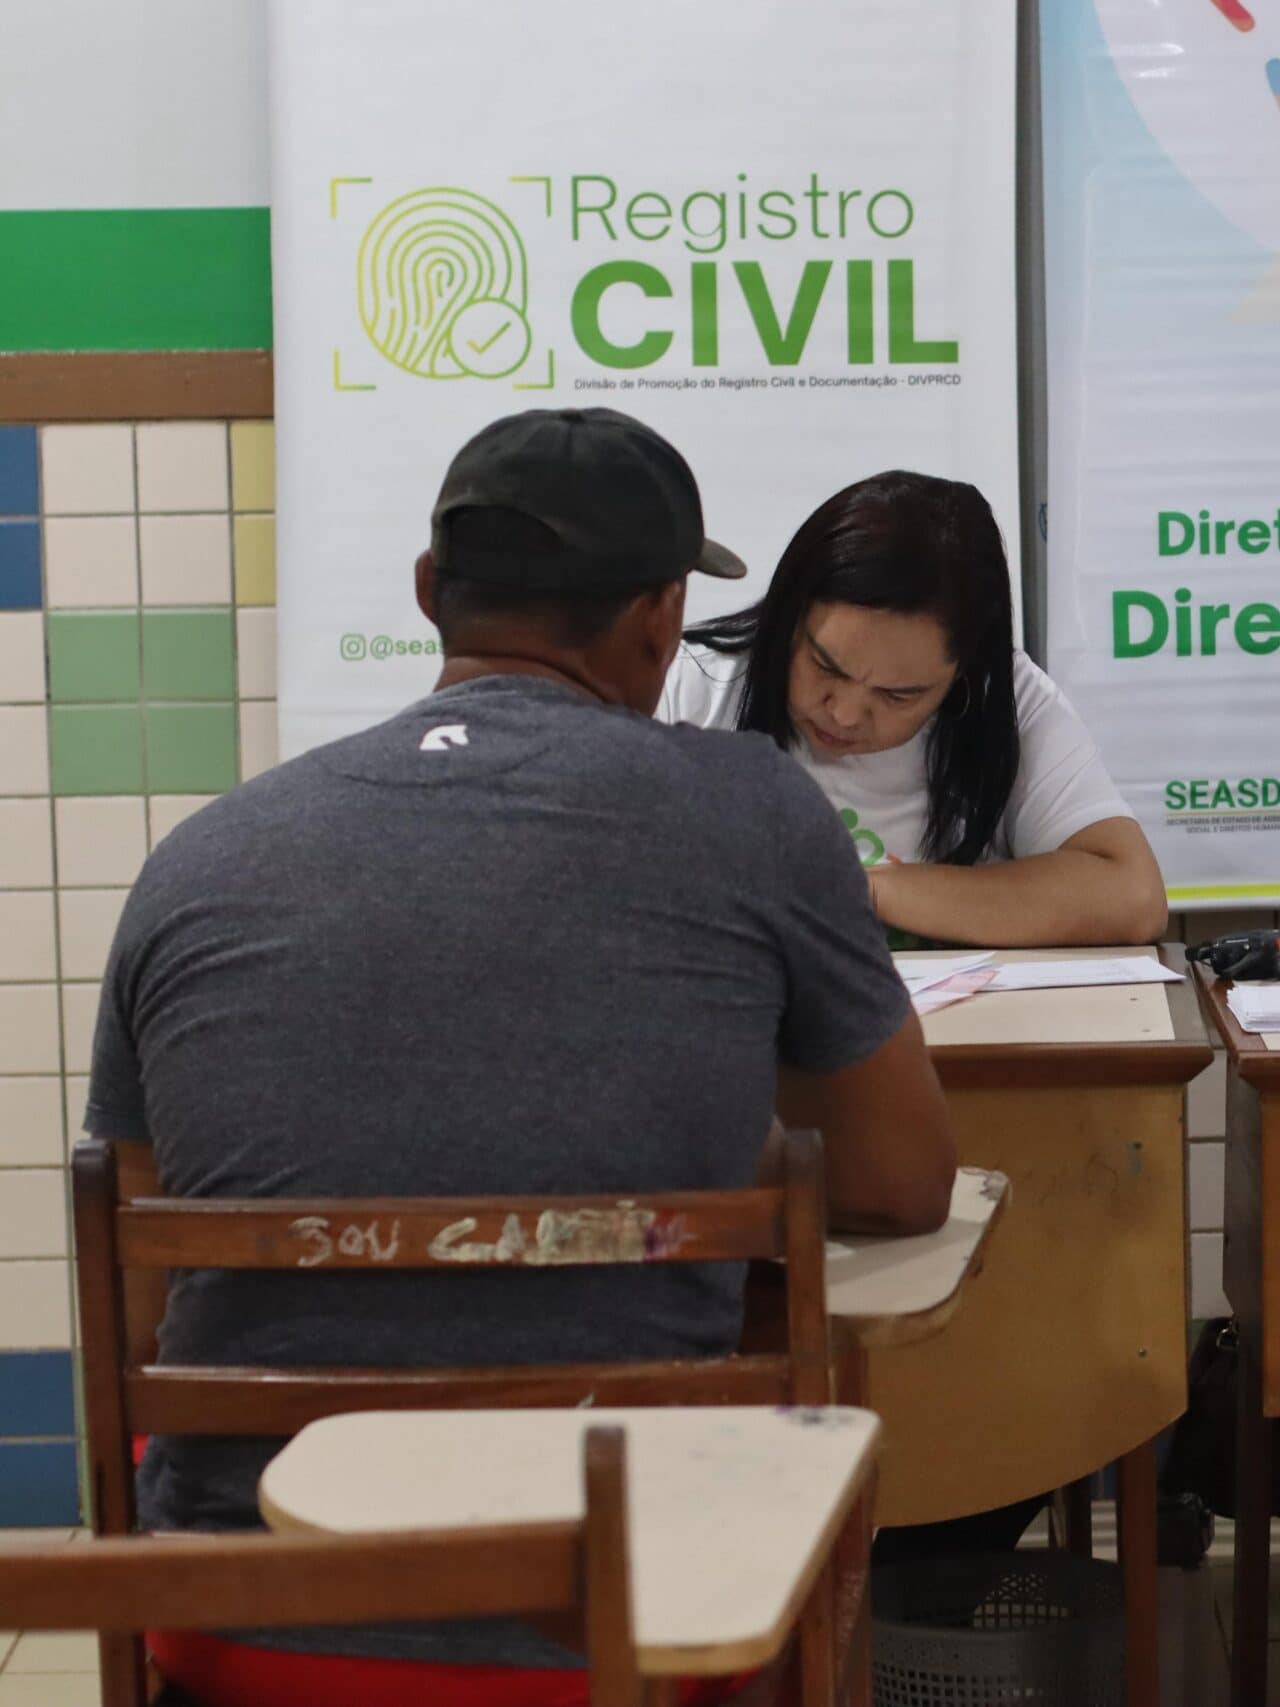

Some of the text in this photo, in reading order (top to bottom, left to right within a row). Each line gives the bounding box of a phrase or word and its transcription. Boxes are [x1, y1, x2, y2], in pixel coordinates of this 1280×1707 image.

[571, 172, 914, 254] Registro
[570, 258, 959, 369] CIVIL
[574, 378, 617, 390] Divisão
[620, 378, 634, 389] de
[637, 377, 698, 391] Promoção
[701, 377, 715, 389] do
[718, 377, 768, 390] Registro
[770, 376, 795, 388] Civil
[798, 379, 805, 388] e
[809, 375, 897, 389] Documentação
[907, 374, 961, 386] DIVPRCD
[370, 634, 442, 660] @sea
